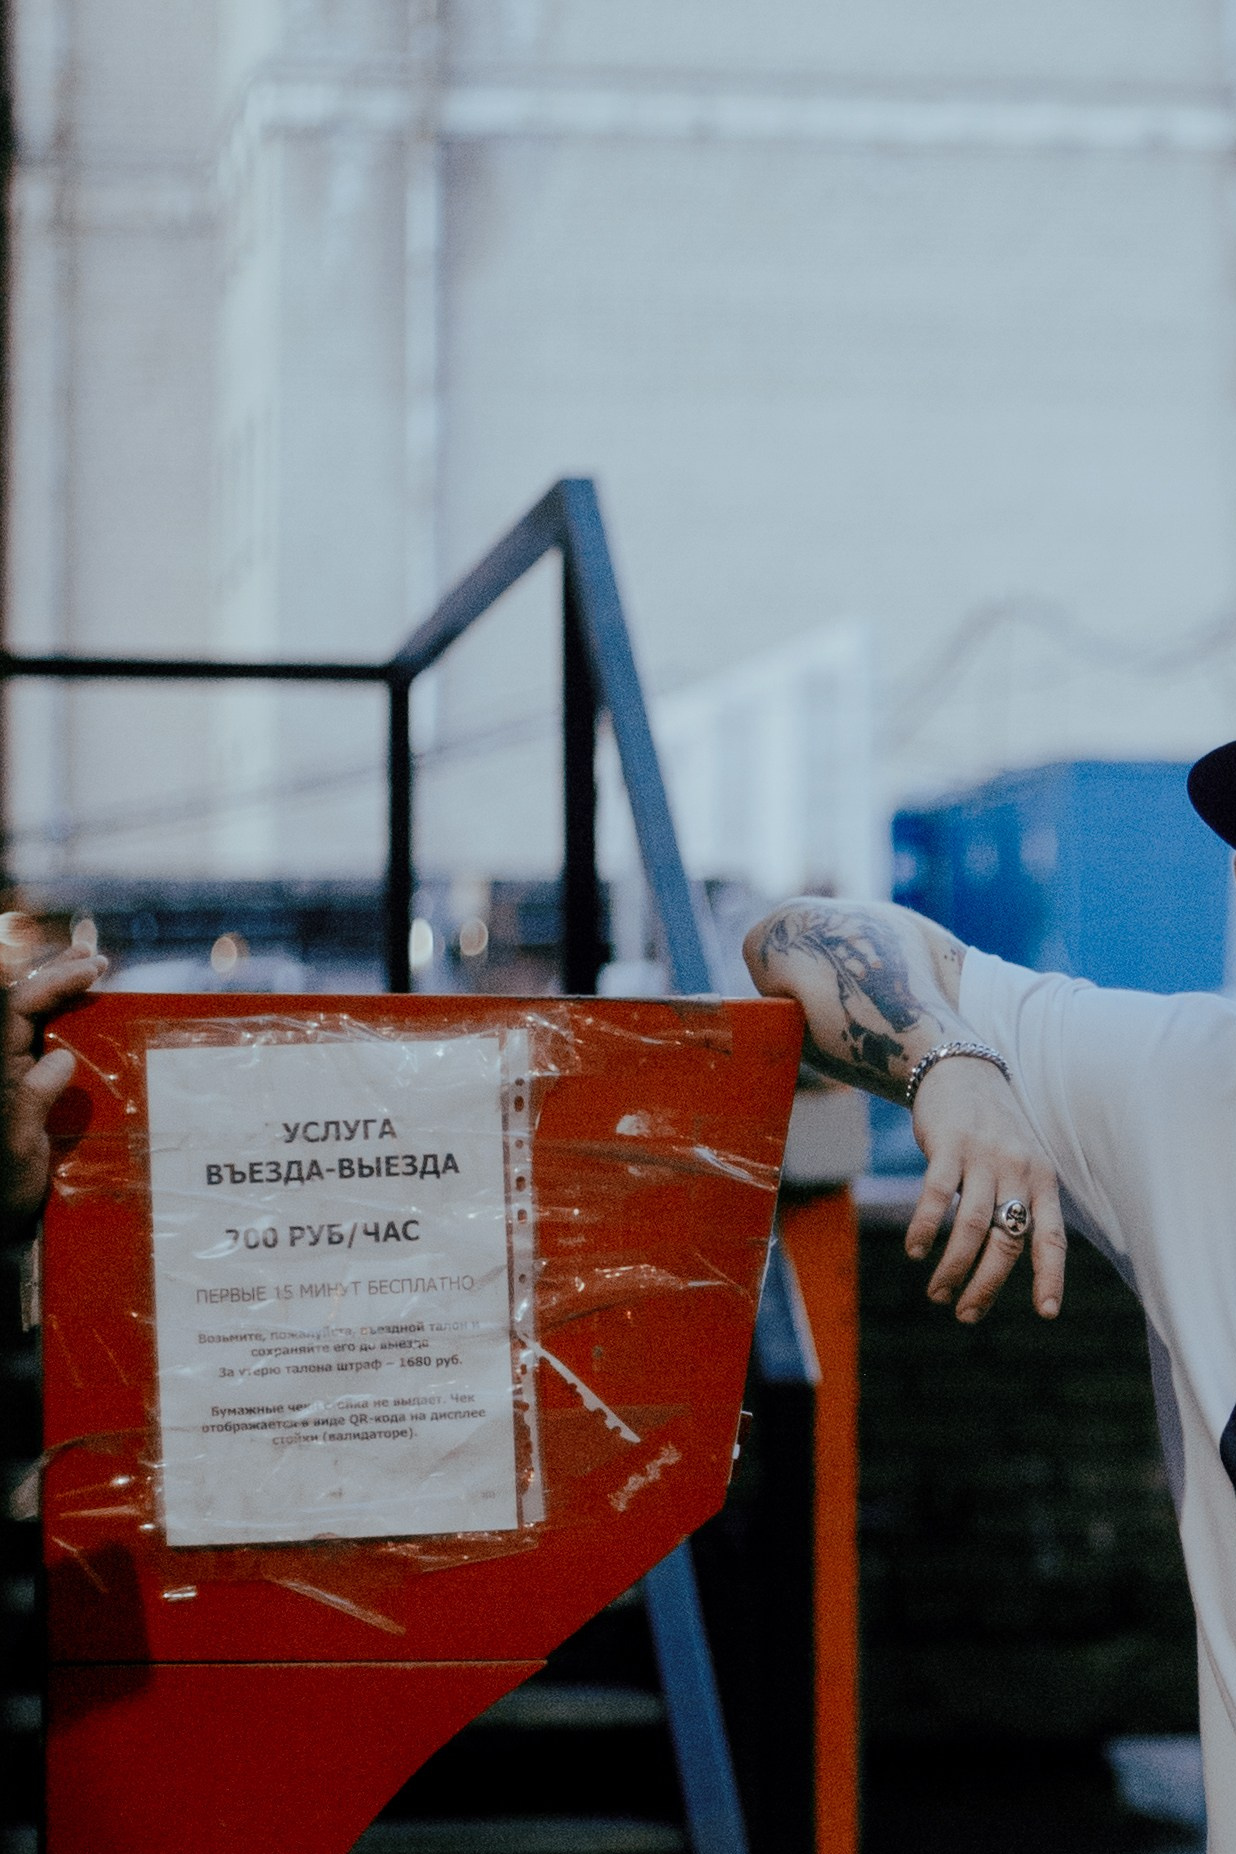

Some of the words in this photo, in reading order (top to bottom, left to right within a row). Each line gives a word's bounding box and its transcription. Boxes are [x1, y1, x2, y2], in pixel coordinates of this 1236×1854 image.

[283, 1118, 397, 1144] УСЛУГА
[206, 1153, 460, 1186] ВЪЕЗДА-ВЫЕЗДА
[289, 1220, 420, 1248] РУБ/ЧАС
[196, 1286, 267, 1304] ПЕРВЫЕ
[275, 1284, 293, 1301] 15
[300, 1281, 362, 1299] МИНУТ
[368, 1275, 475, 1296] БЕСПЛАТНО
[286, 1362, 332, 1375] талона
[337, 1358, 382, 1373] штраф
[400, 1355, 431, 1368] 1680
